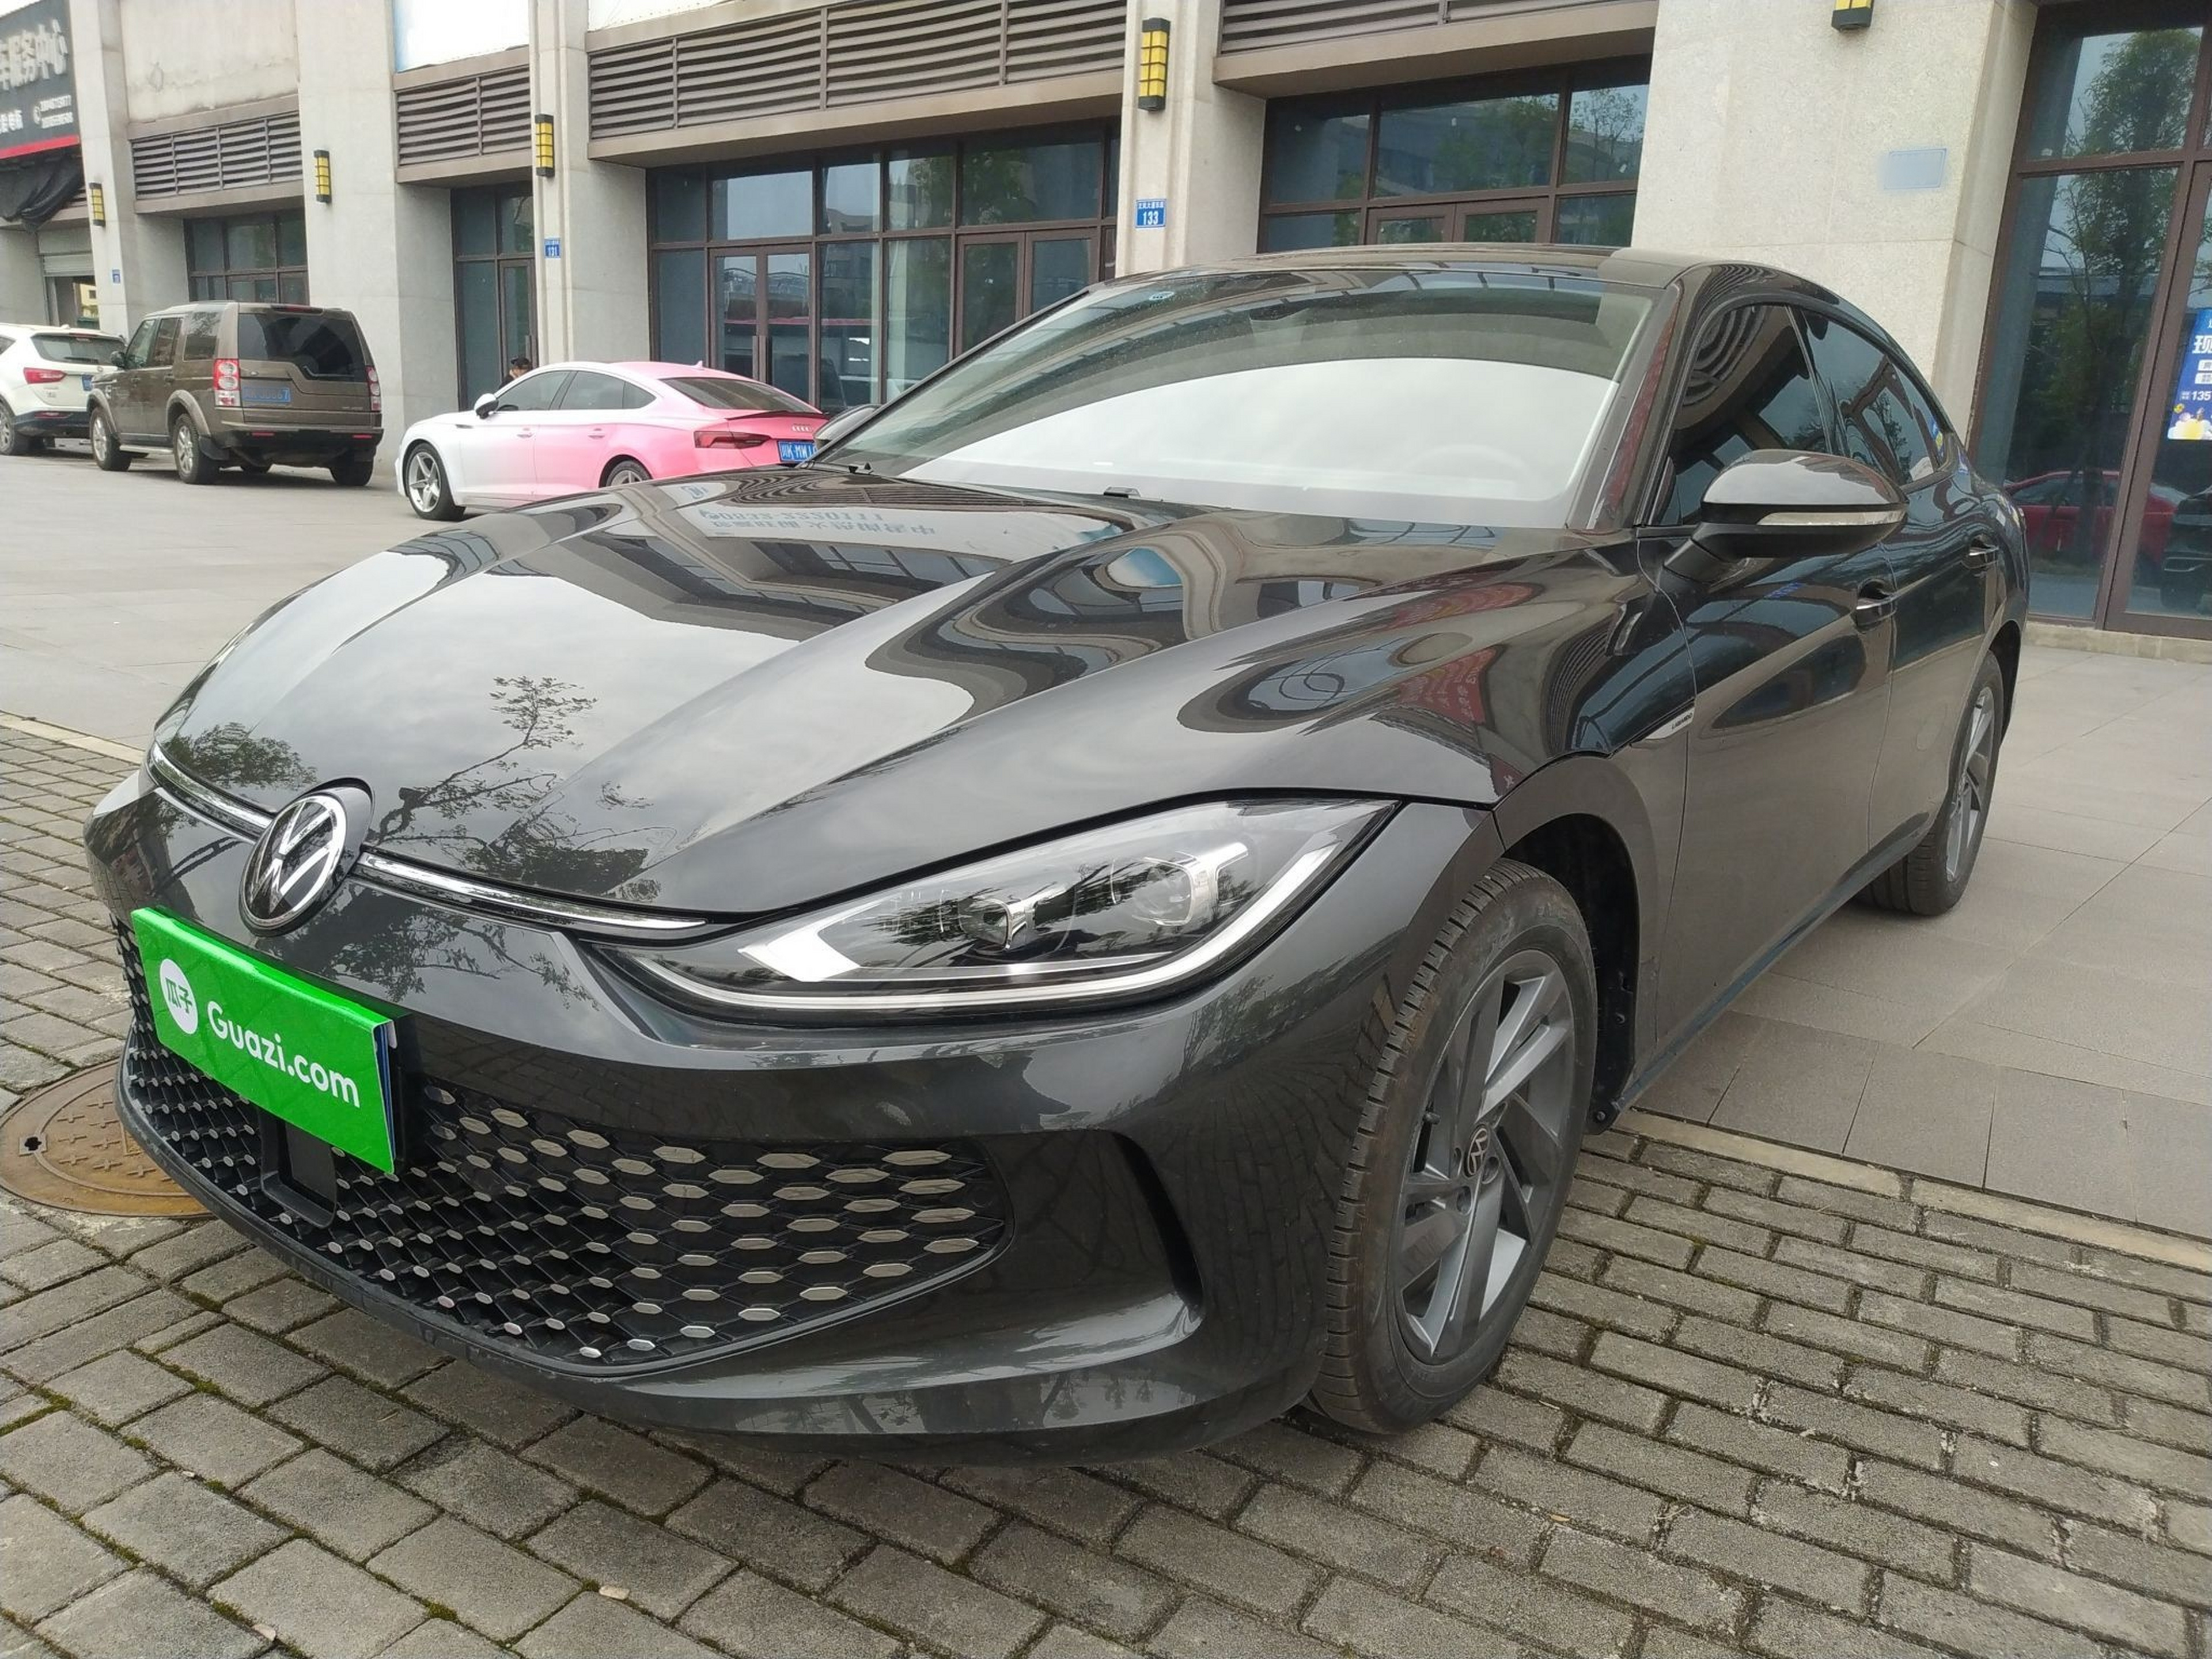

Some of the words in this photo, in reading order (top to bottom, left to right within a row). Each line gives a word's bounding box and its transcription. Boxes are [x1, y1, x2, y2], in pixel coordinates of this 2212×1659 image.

[1143, 211, 1159, 225] 133
[165, 976, 194, 1017] 瓜子
[207, 1001, 361, 1108] Guazi.com
